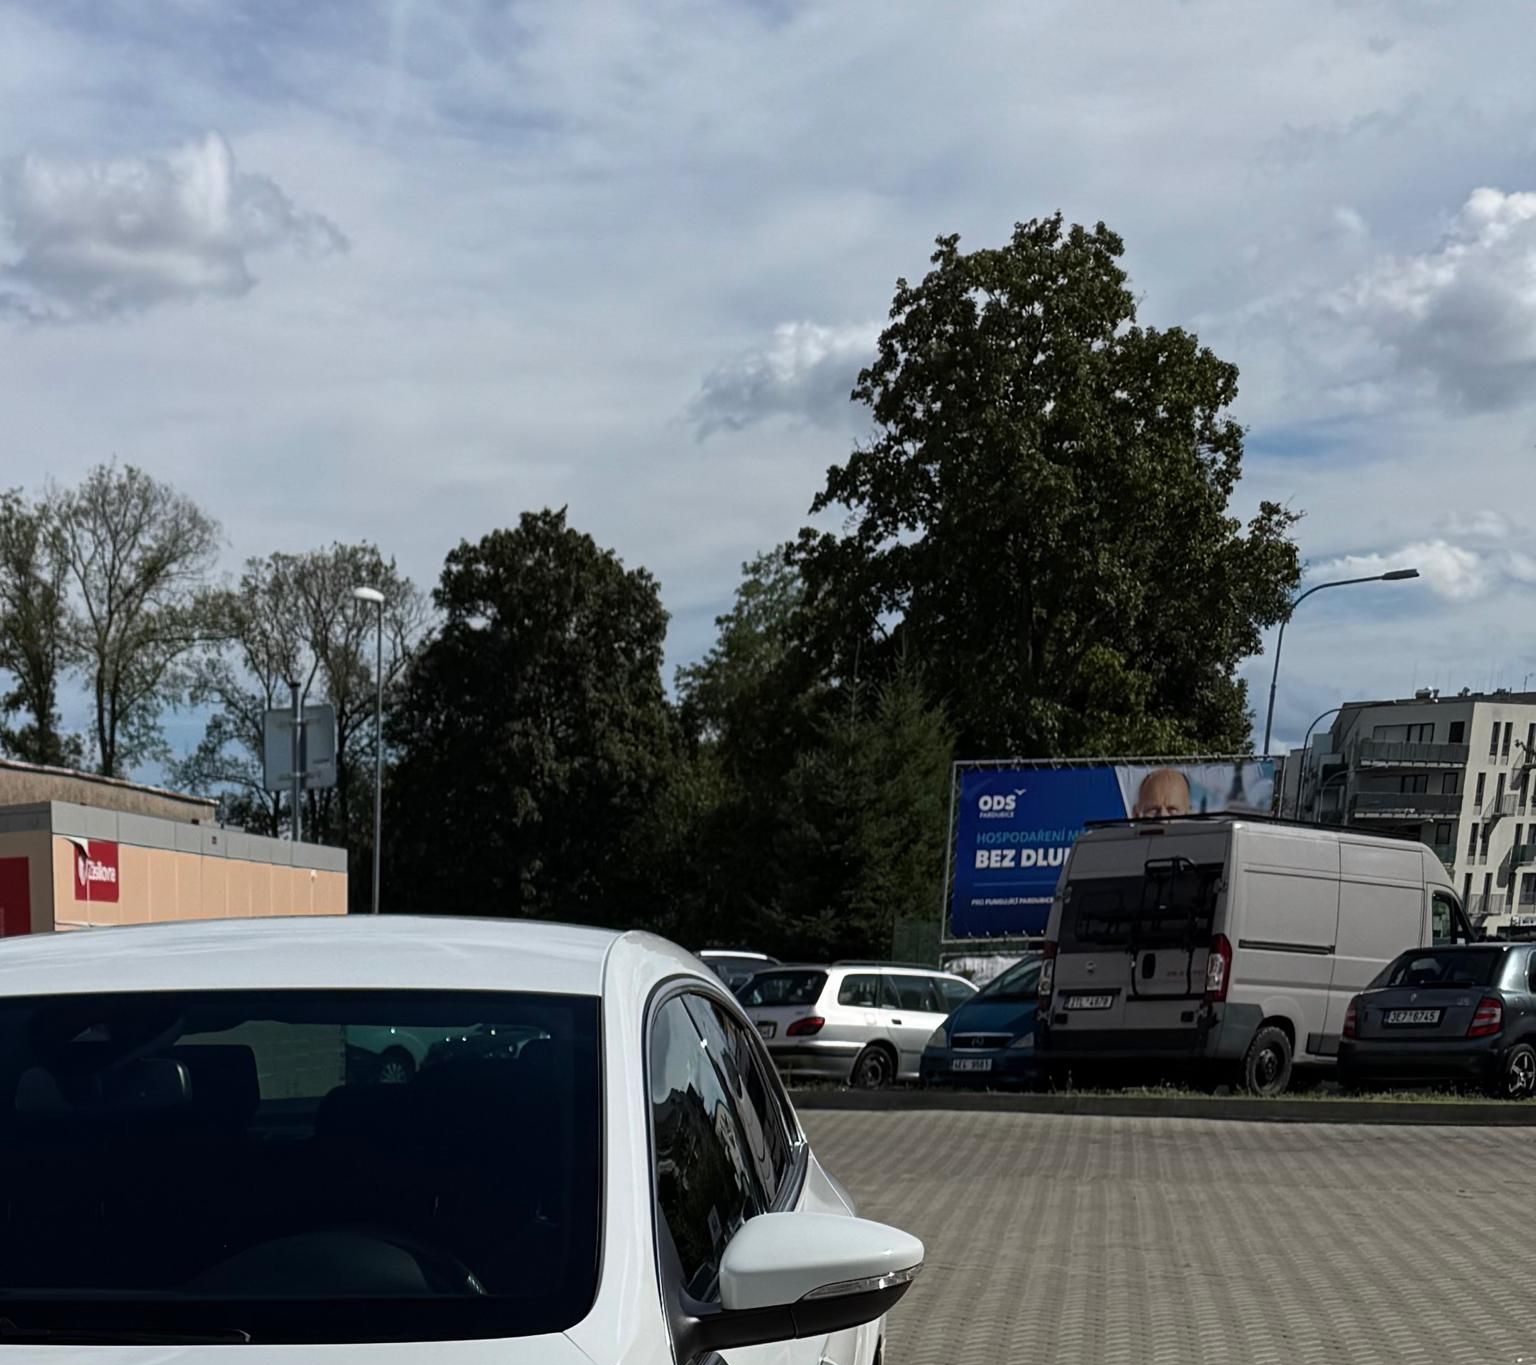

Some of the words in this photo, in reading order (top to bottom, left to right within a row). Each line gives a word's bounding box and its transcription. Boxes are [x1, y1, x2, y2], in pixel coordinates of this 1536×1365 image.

[978, 795, 1016, 811] ODS
[976, 827, 1066, 845] HOSPODAŘENÍ
[975, 849, 1016, 869] BEZ
